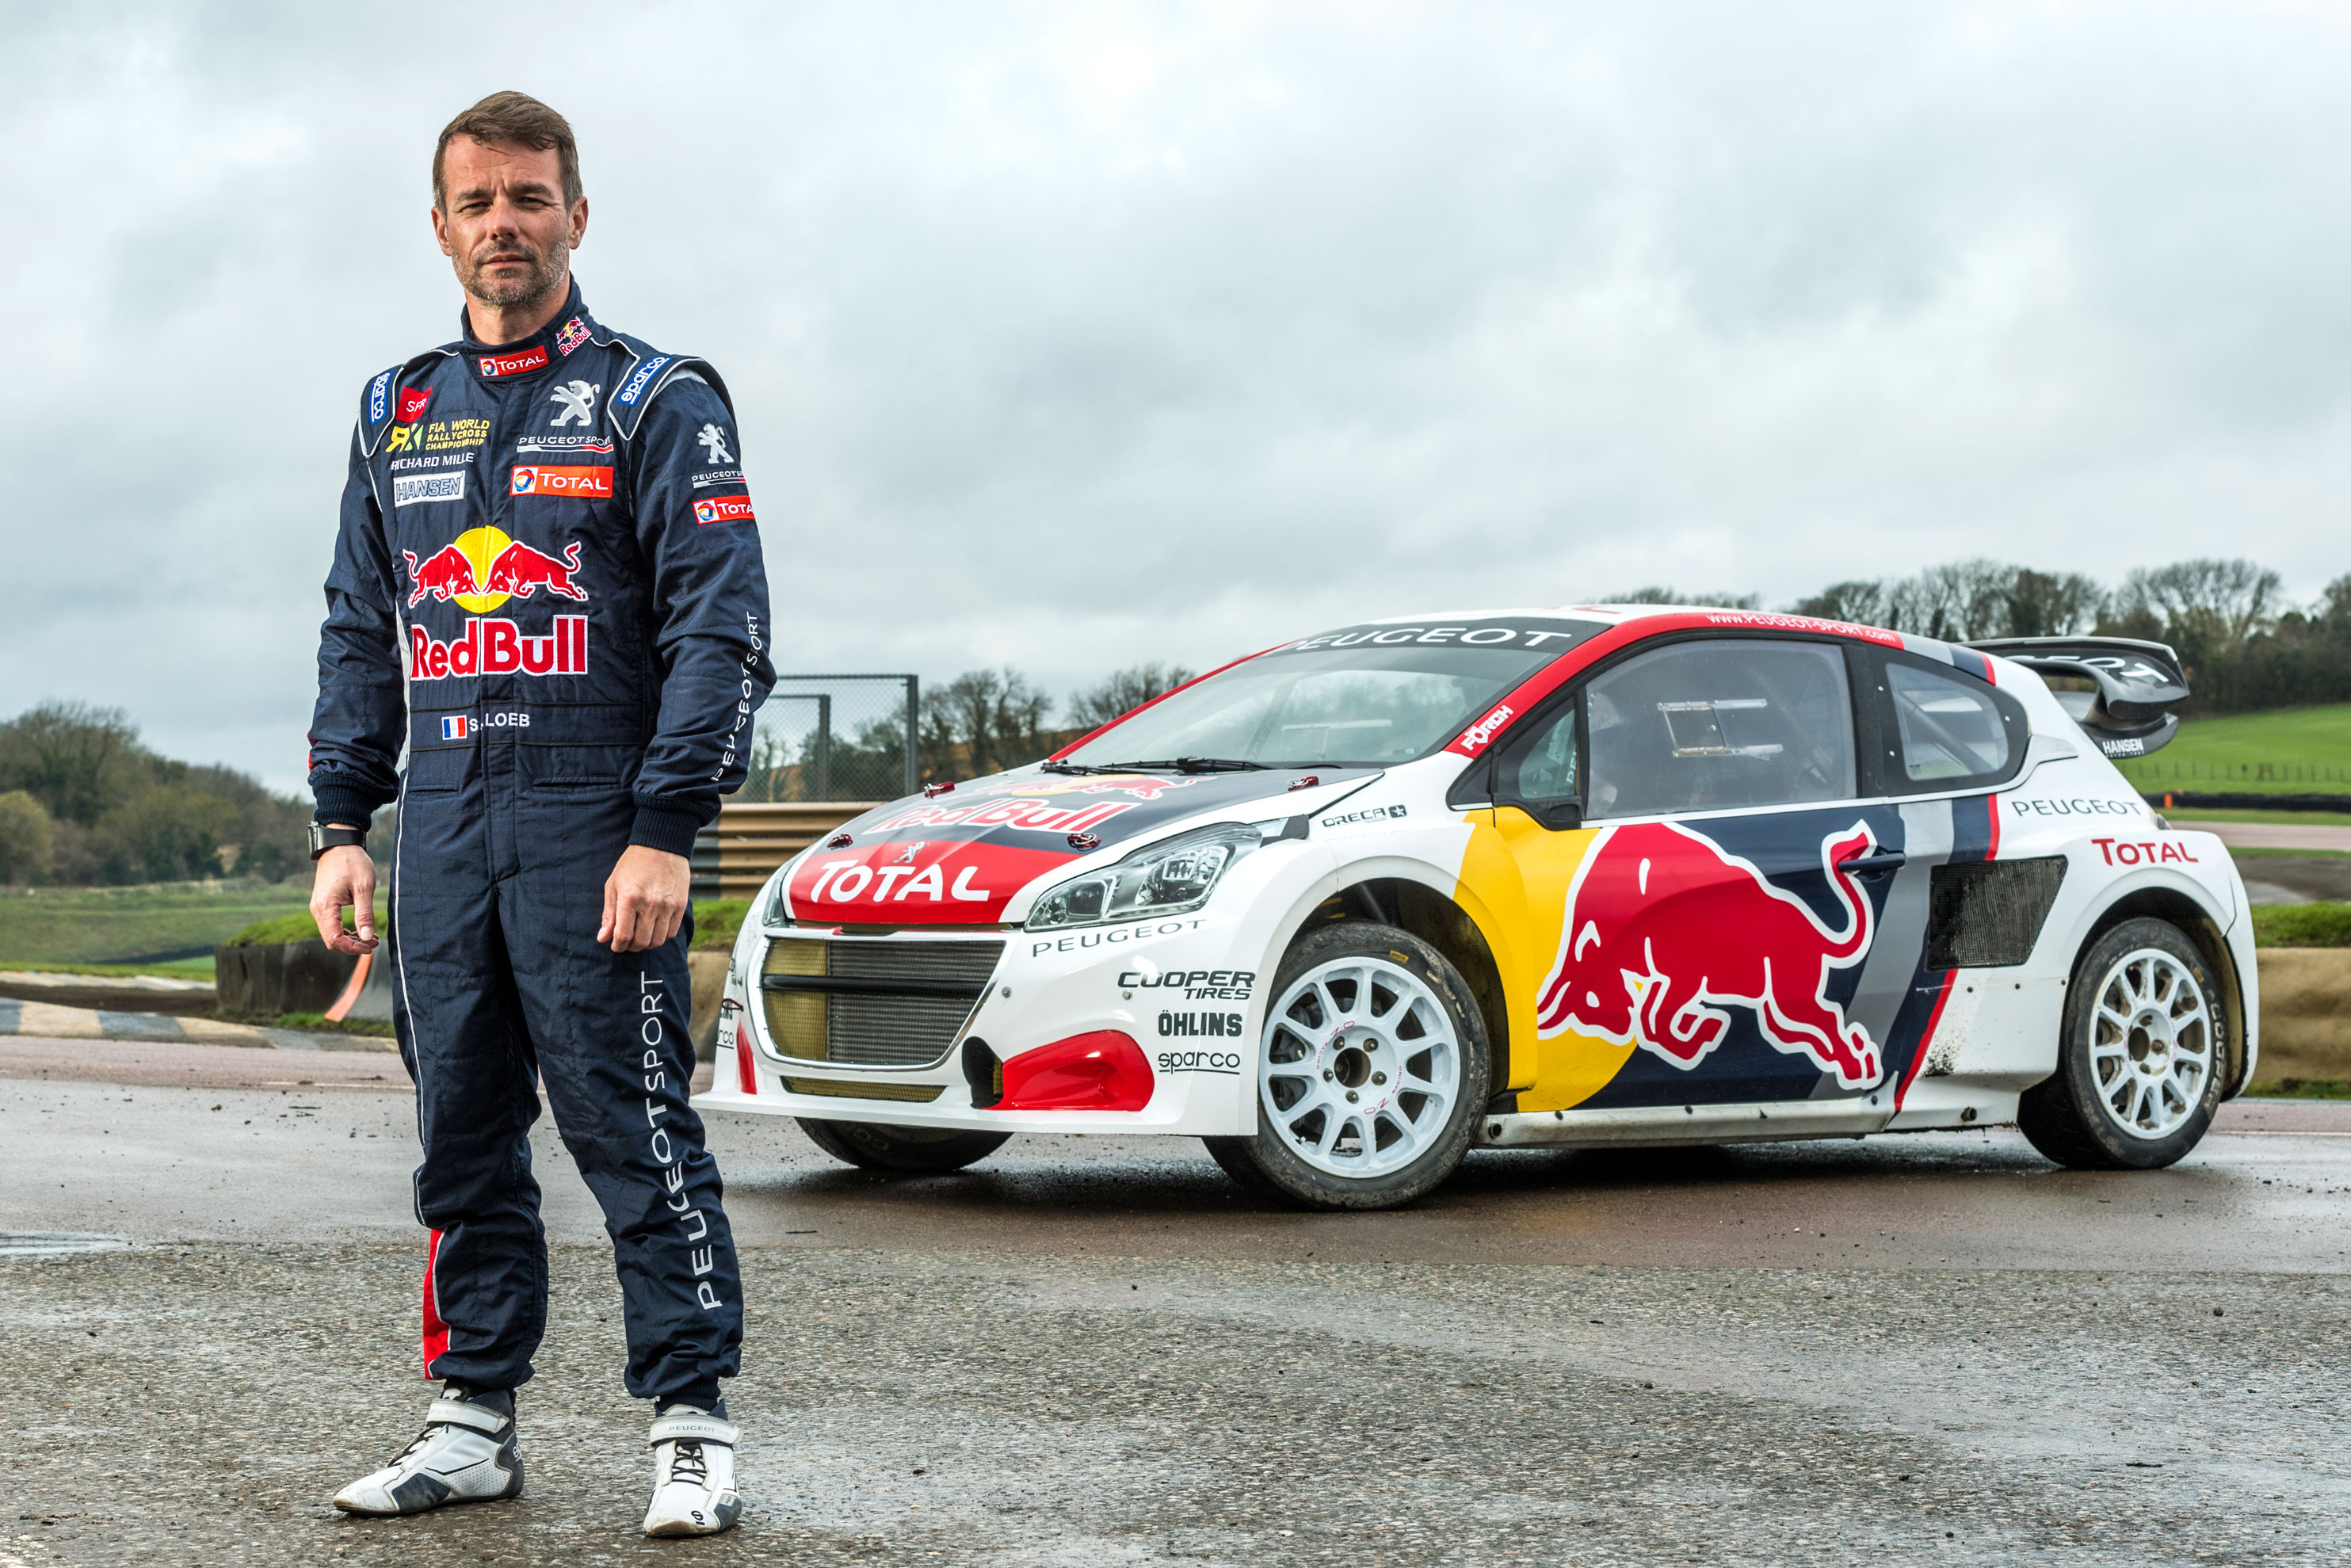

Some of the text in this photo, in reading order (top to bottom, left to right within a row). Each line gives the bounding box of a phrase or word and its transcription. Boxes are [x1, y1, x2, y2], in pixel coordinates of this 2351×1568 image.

[497, 356, 545, 371] TOTAL
[372, 372, 391, 420] sparco
[406, 397, 428, 413] SFR
[428, 419, 490, 433] FIA WORLD
[427, 429, 487, 442] RALLYCROSS
[391, 452, 475, 471] RICHARD MILLE
[395, 477, 461, 501] HANSEN
[539, 473, 609, 490] TOTAL
[2102, 738, 2144, 753] HANSEN
[1322, 807, 1387, 827] ORECA
[2011, 799, 2144, 817] PEUGEOT
[2091, 837, 2199, 867] TOTAL
[811, 860, 990, 904] TOTAL
[1032, 919, 1208, 957] PEUGEOT
[1117, 971, 1256, 989] COOPER
[1183, 988, 1252, 1000] TIRES
[1158, 1010, 1242, 1037] ÖHLINS
[1158, 1051, 1241, 1074] sparco
